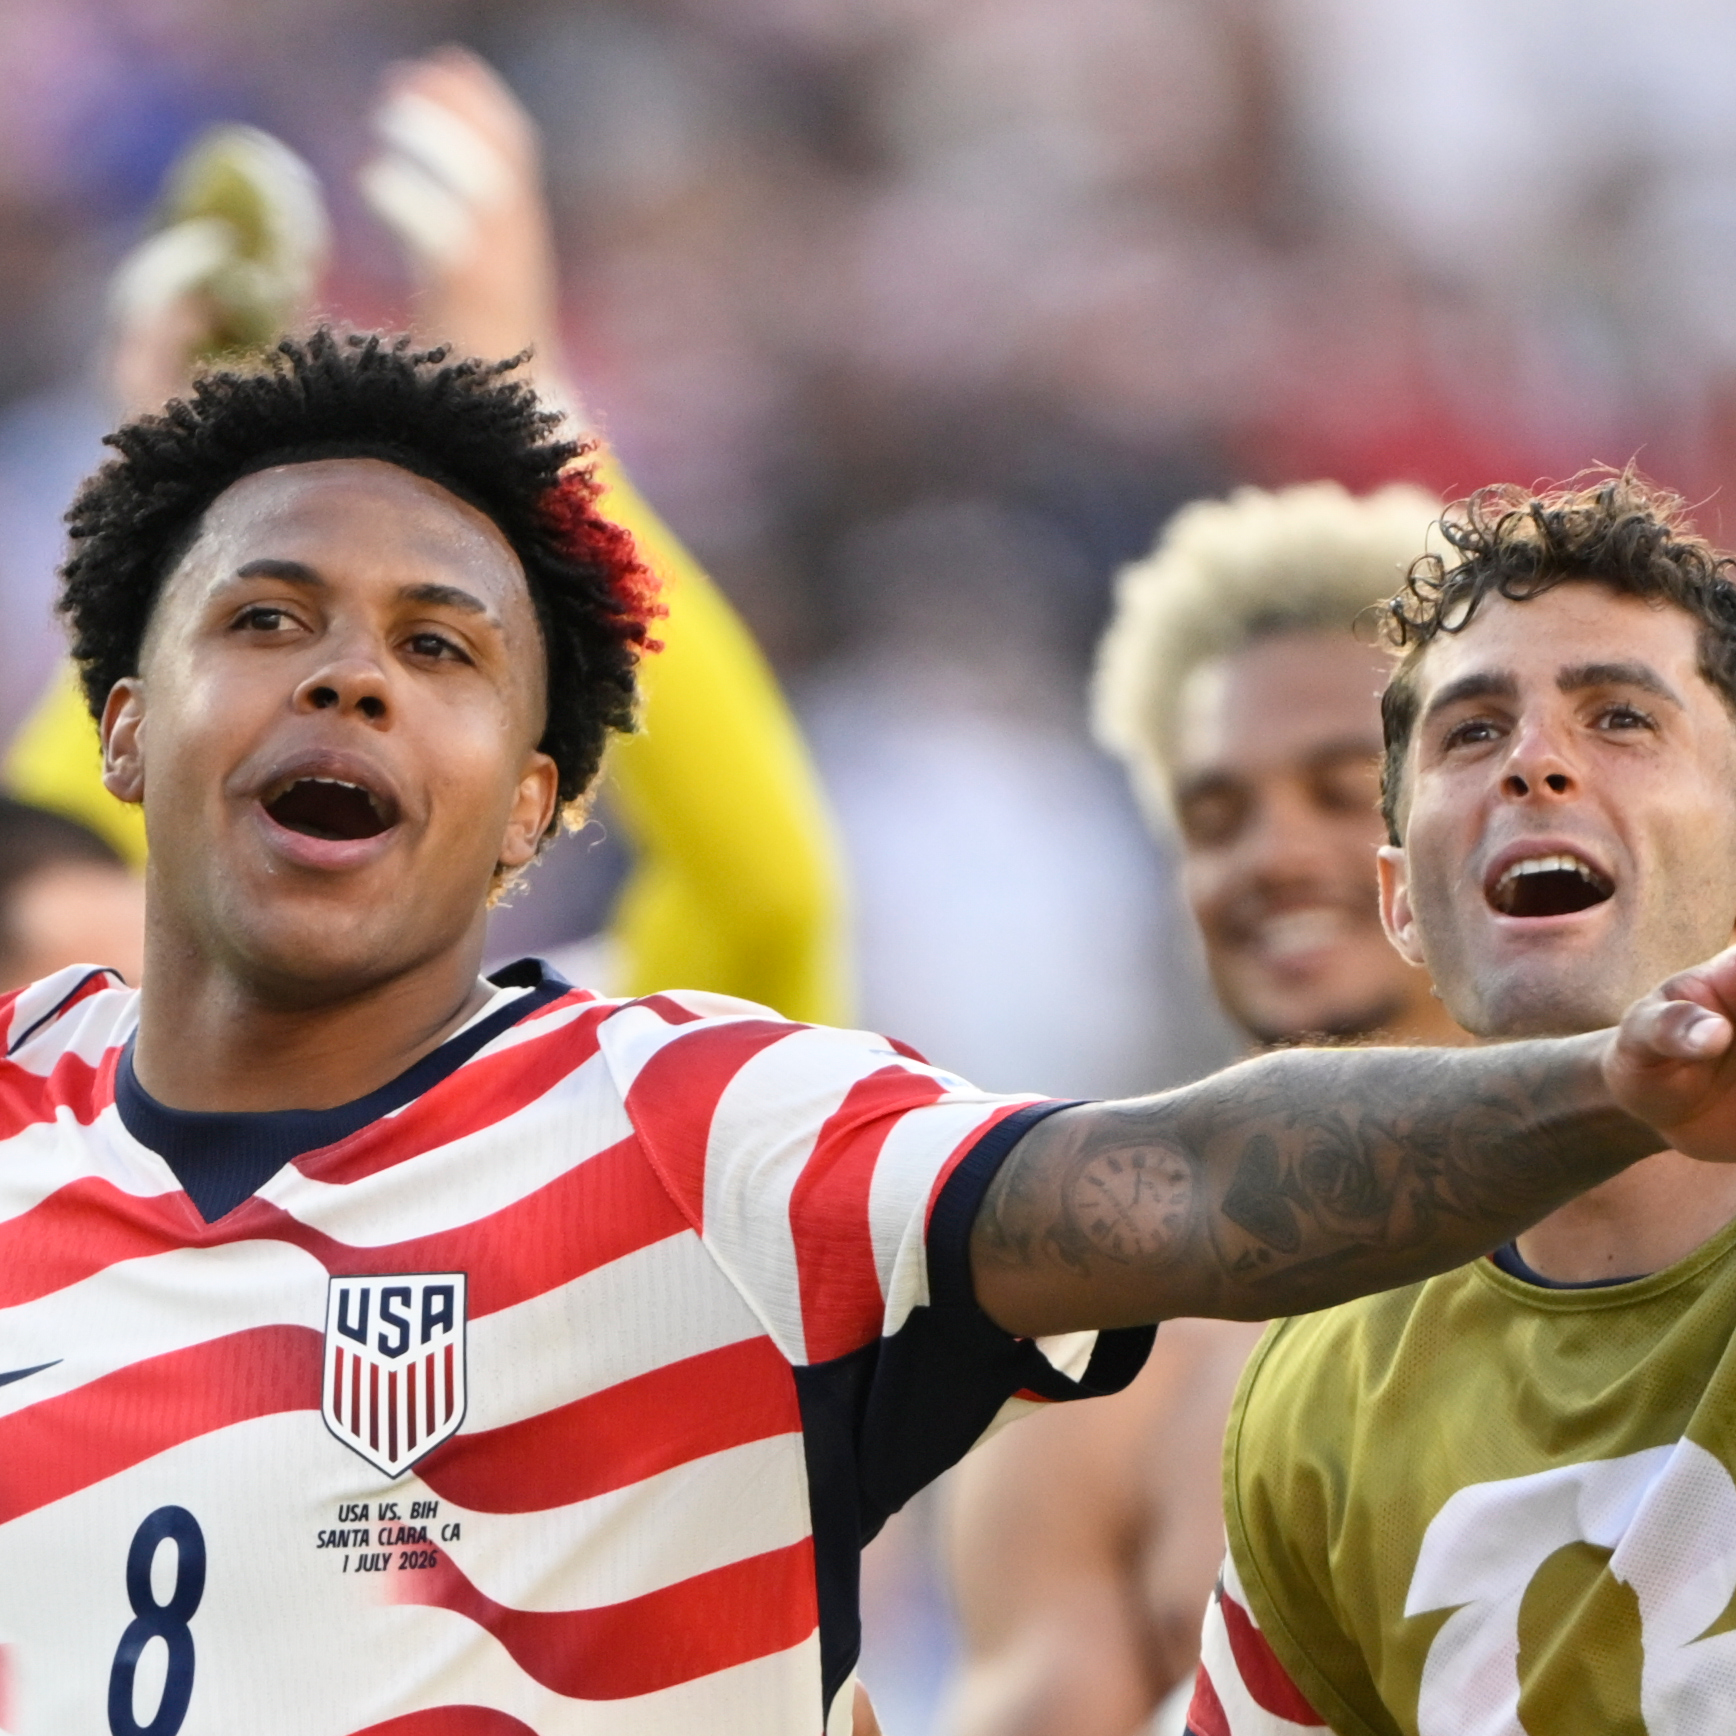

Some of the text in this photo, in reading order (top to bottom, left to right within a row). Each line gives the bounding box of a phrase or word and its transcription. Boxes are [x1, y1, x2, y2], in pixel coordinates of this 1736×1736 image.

[337, 1284, 454, 1359] USA
[338, 1500, 439, 1523] USA VS. BIH
[316, 1523, 461, 1548] SANTA CLARA, CA
[342, 1550, 438, 1573] 1 JULY 2026
